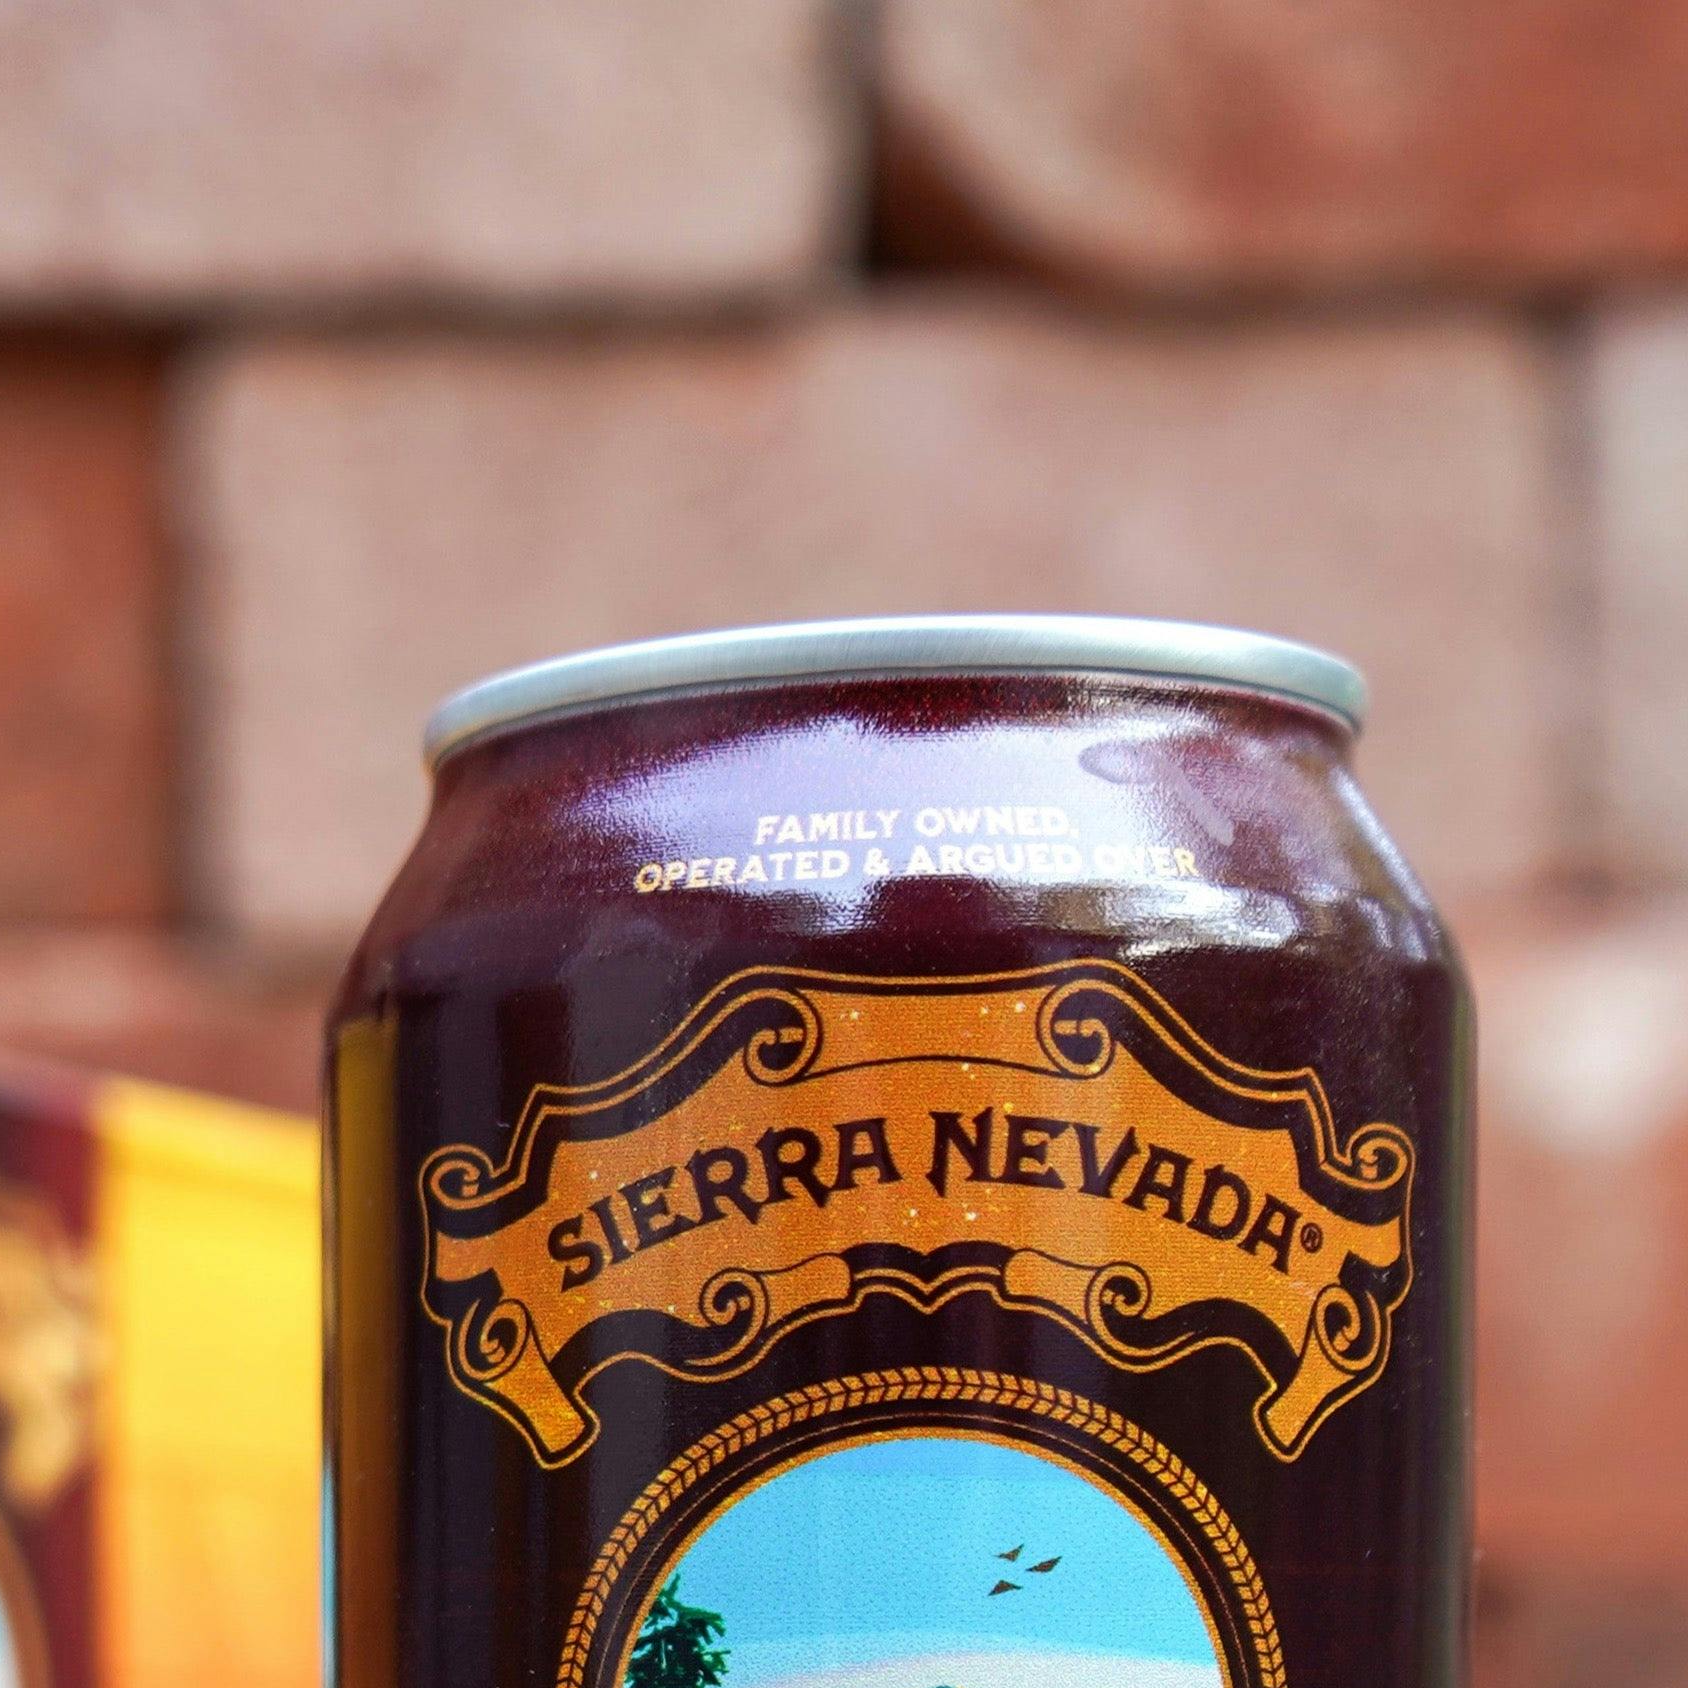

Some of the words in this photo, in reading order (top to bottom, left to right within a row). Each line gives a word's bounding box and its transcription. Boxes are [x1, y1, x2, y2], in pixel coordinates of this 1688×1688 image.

[754, 808, 902, 846] FAMILY
[633, 849, 850, 893] OPERATED
[863, 846, 891, 876] &
[906, 843, 1083, 876] ARGUED
[1094, 845, 1199, 878] OVER
[547, 1117, 904, 1293] SIERRA
